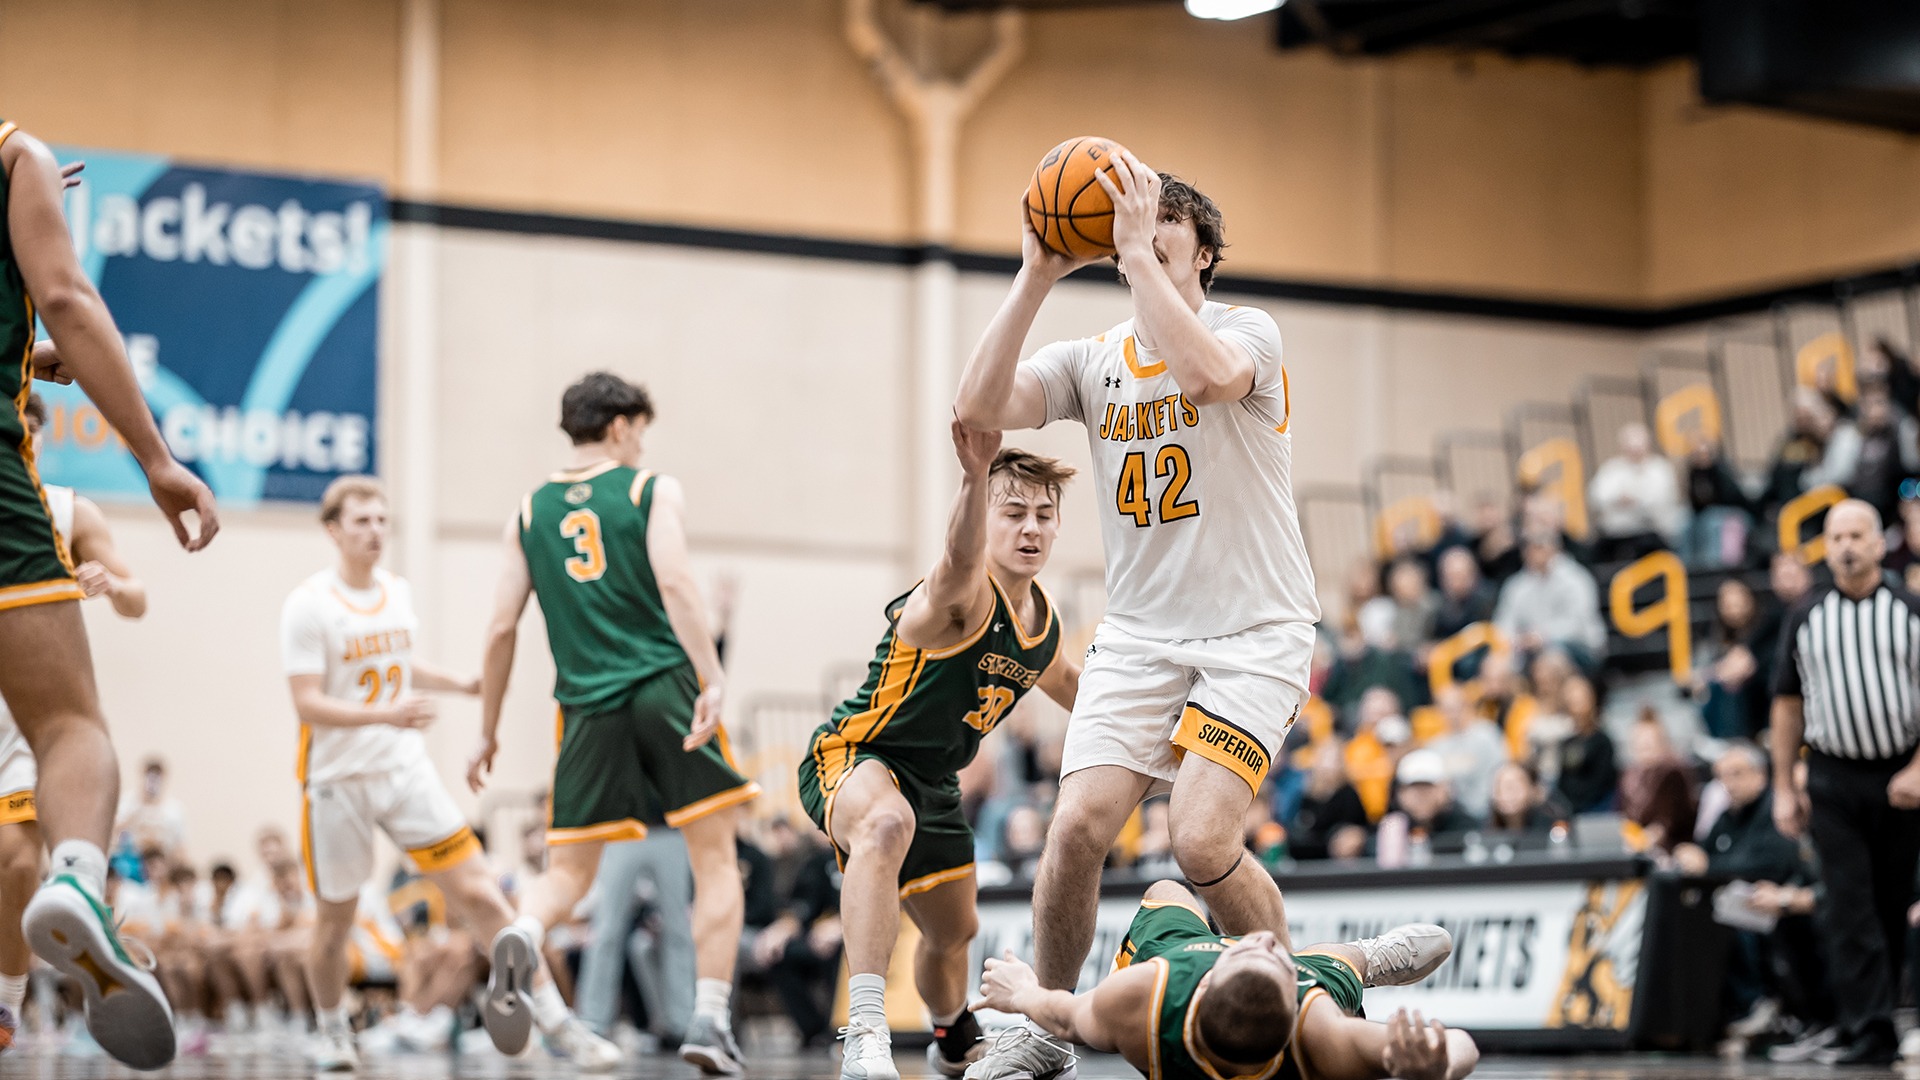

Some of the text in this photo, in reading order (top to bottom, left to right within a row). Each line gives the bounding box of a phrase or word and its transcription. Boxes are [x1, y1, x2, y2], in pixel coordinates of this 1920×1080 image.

[68, 184, 372, 275] Jackets!
[162, 403, 369, 472] CHOICE
[1116, 443, 1200, 528] 42
[559, 508, 607, 583] 3
[1198, 723, 1264, 776] SUPERIOR
